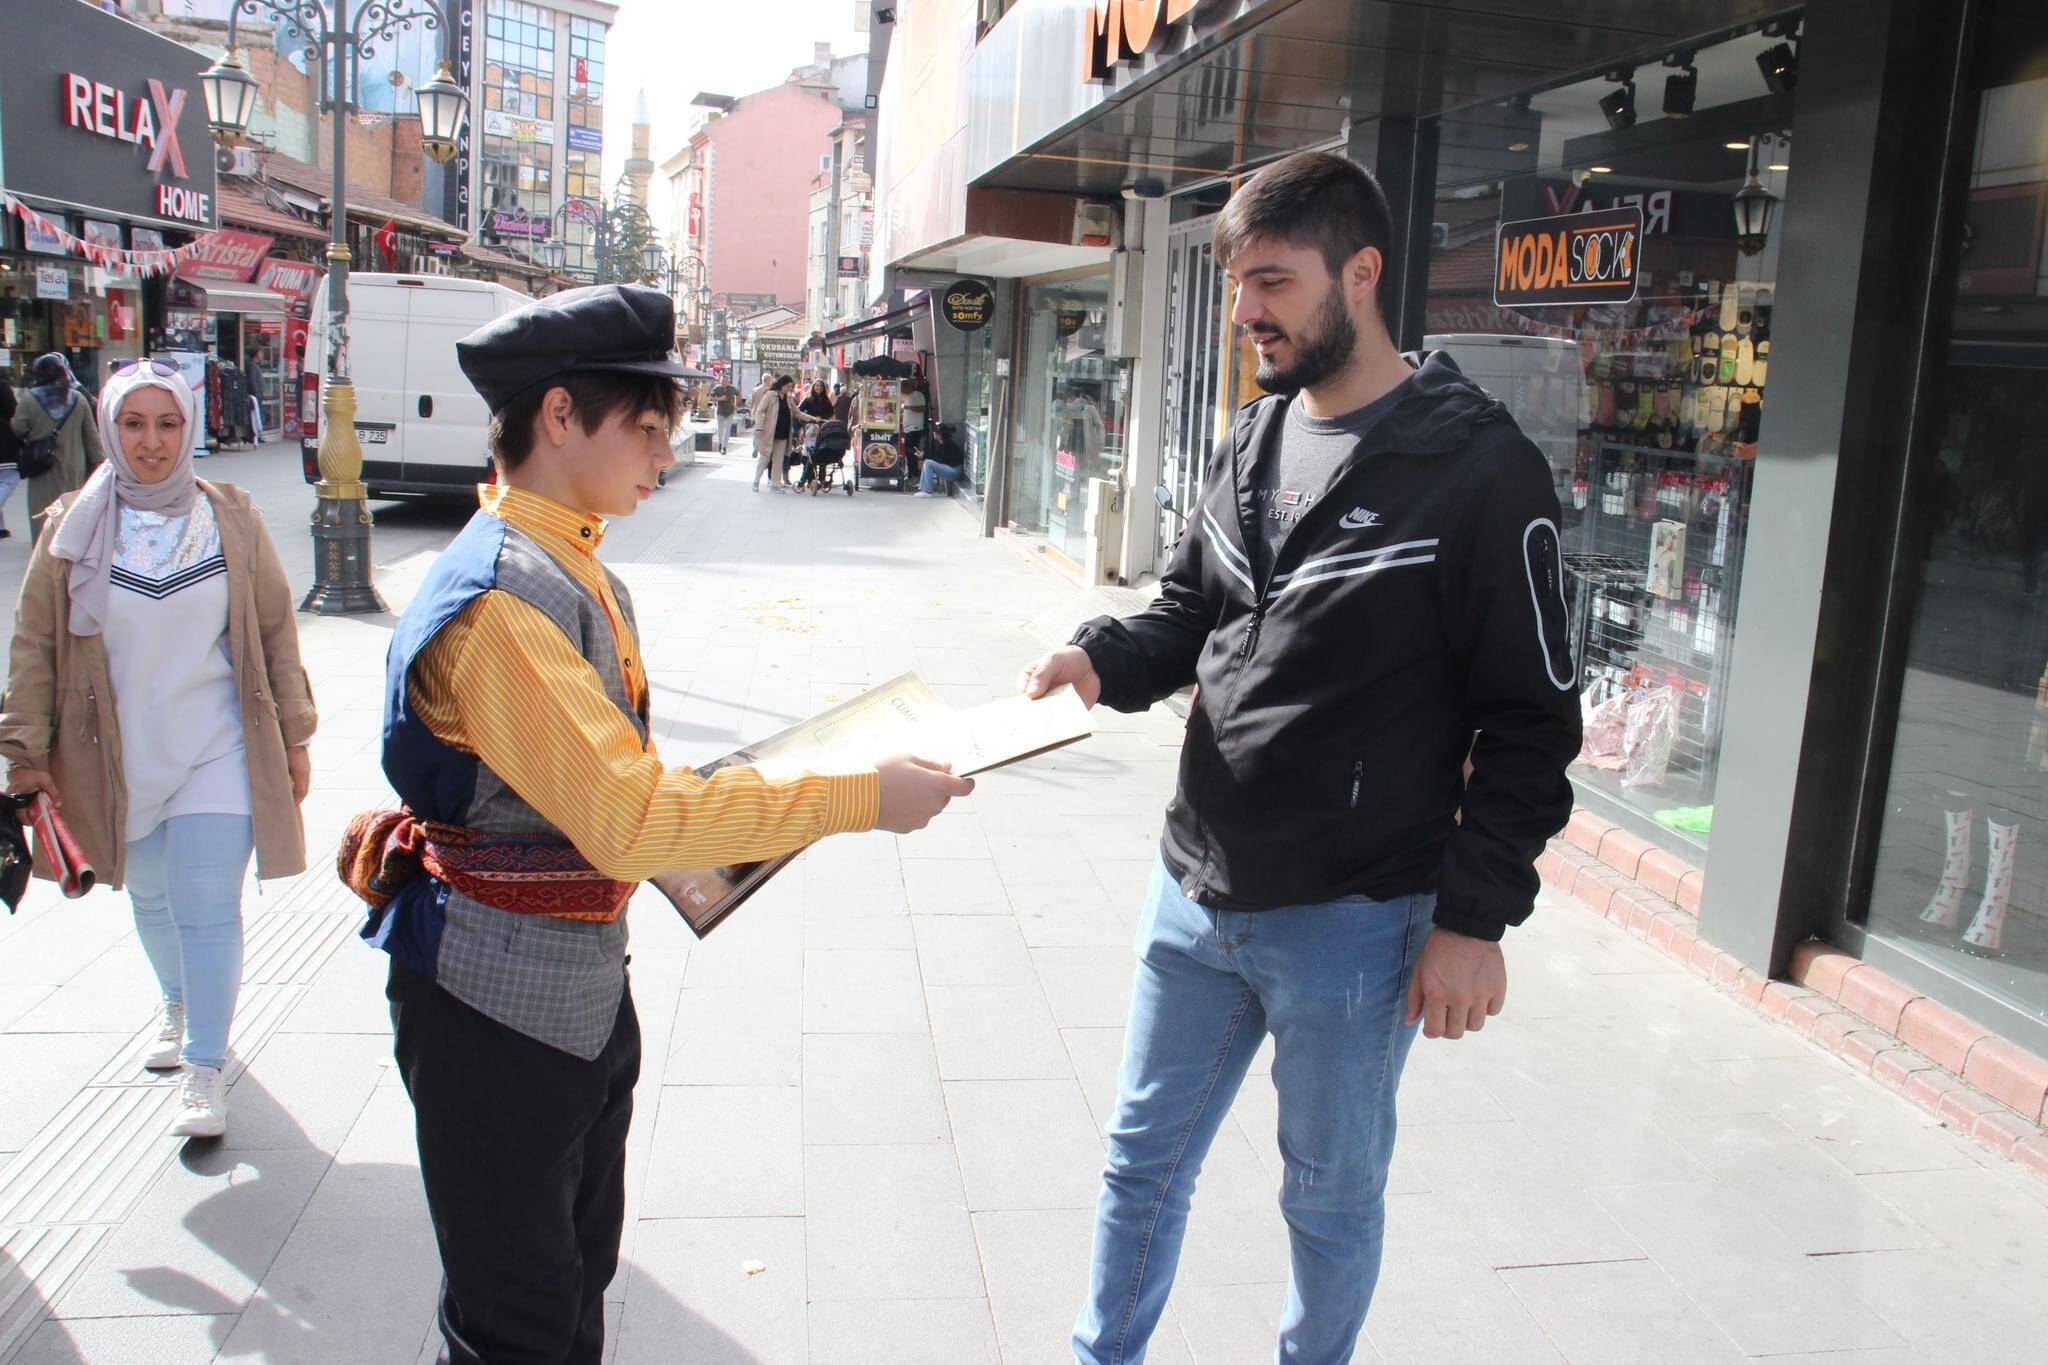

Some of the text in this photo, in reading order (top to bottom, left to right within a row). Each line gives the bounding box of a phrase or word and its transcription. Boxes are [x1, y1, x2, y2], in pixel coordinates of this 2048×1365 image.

[63, 72, 189, 178] RELAX
[156, 184, 209, 222] HOME
[1500, 231, 1569, 291] MODA
[40, 270, 67, 284] Tefal
[274, 267, 305, 289] TUNA
[952, 312, 983, 320] somfy
[284, 383, 297, 393] TU
[370, 431, 386, 441] 735
[1268, 508, 1305, 523] EST. 19
[1349, 506, 1380, 524] NIKE
